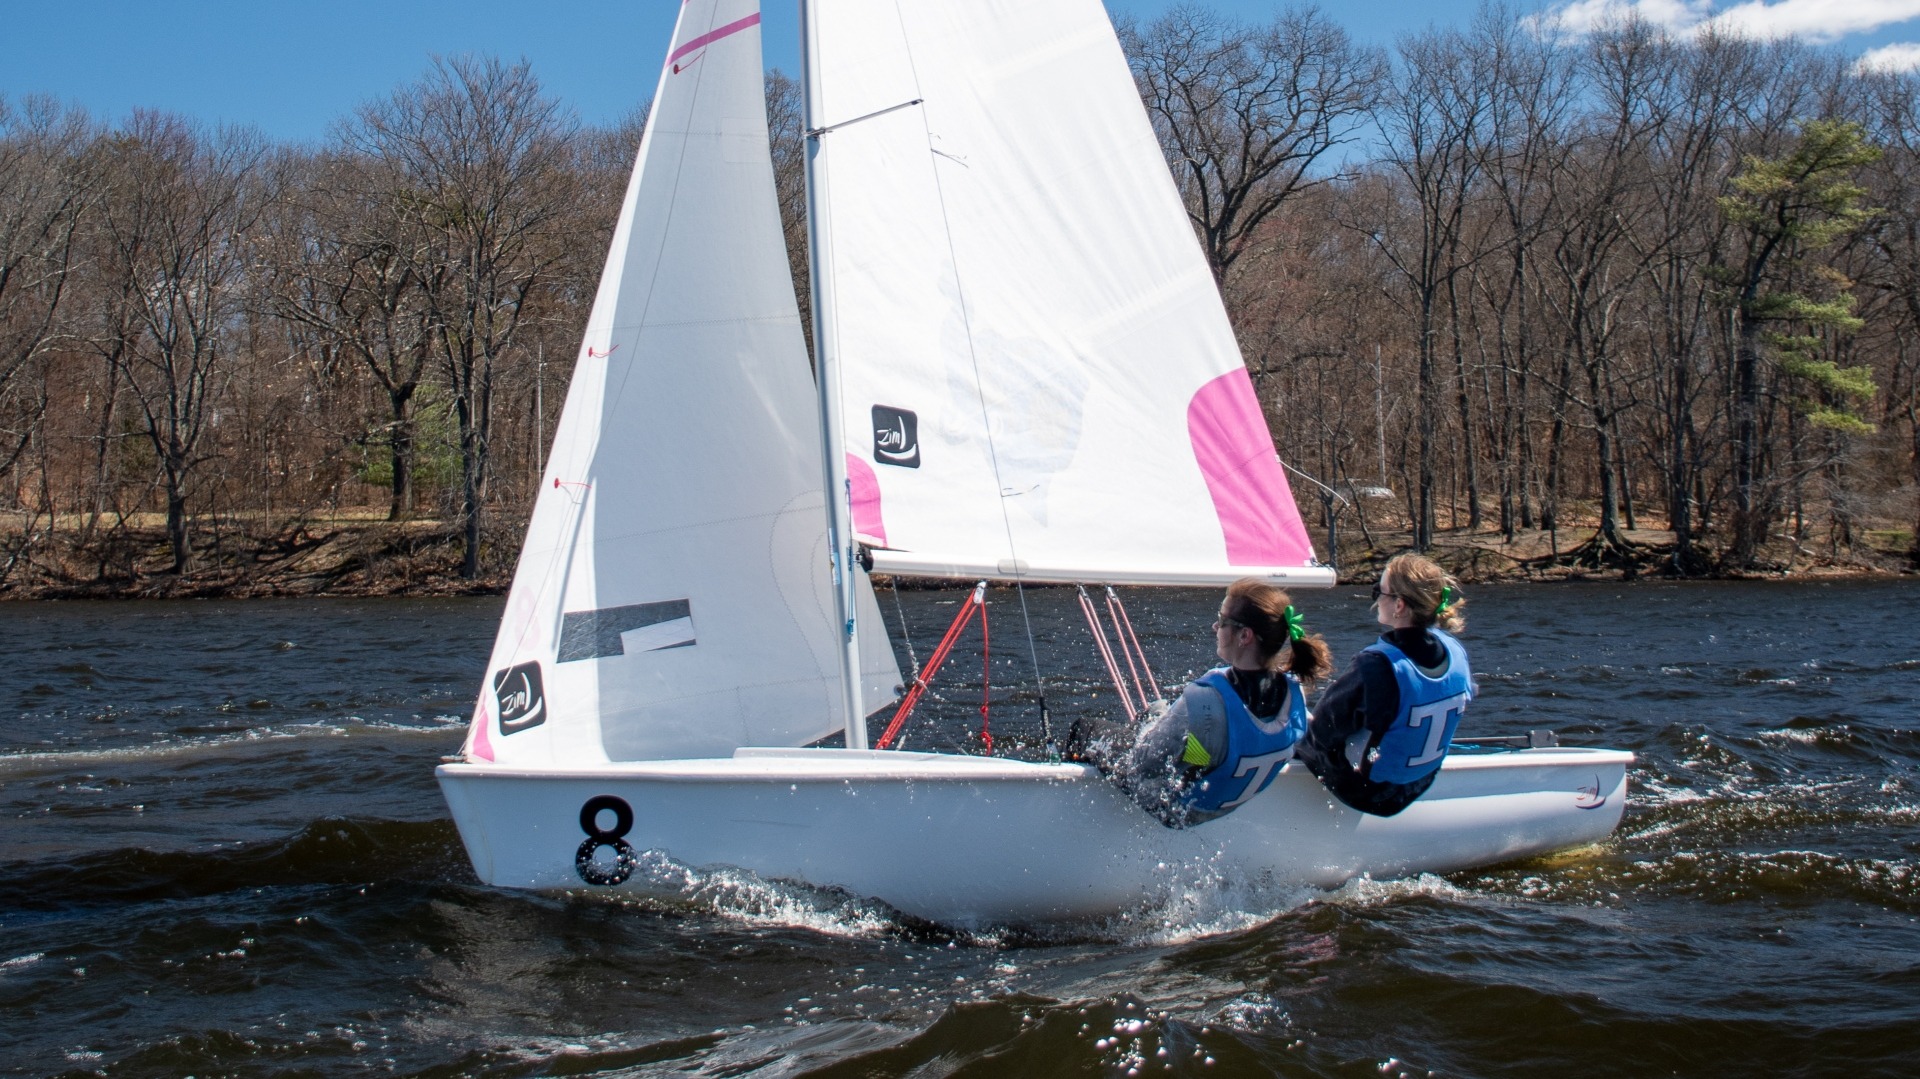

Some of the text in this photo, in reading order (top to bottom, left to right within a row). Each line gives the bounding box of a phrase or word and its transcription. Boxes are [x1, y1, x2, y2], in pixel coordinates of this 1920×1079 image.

[1407, 690, 1466, 767] T
[1220, 743, 1294, 808] T
[575, 794, 635, 886] 8
